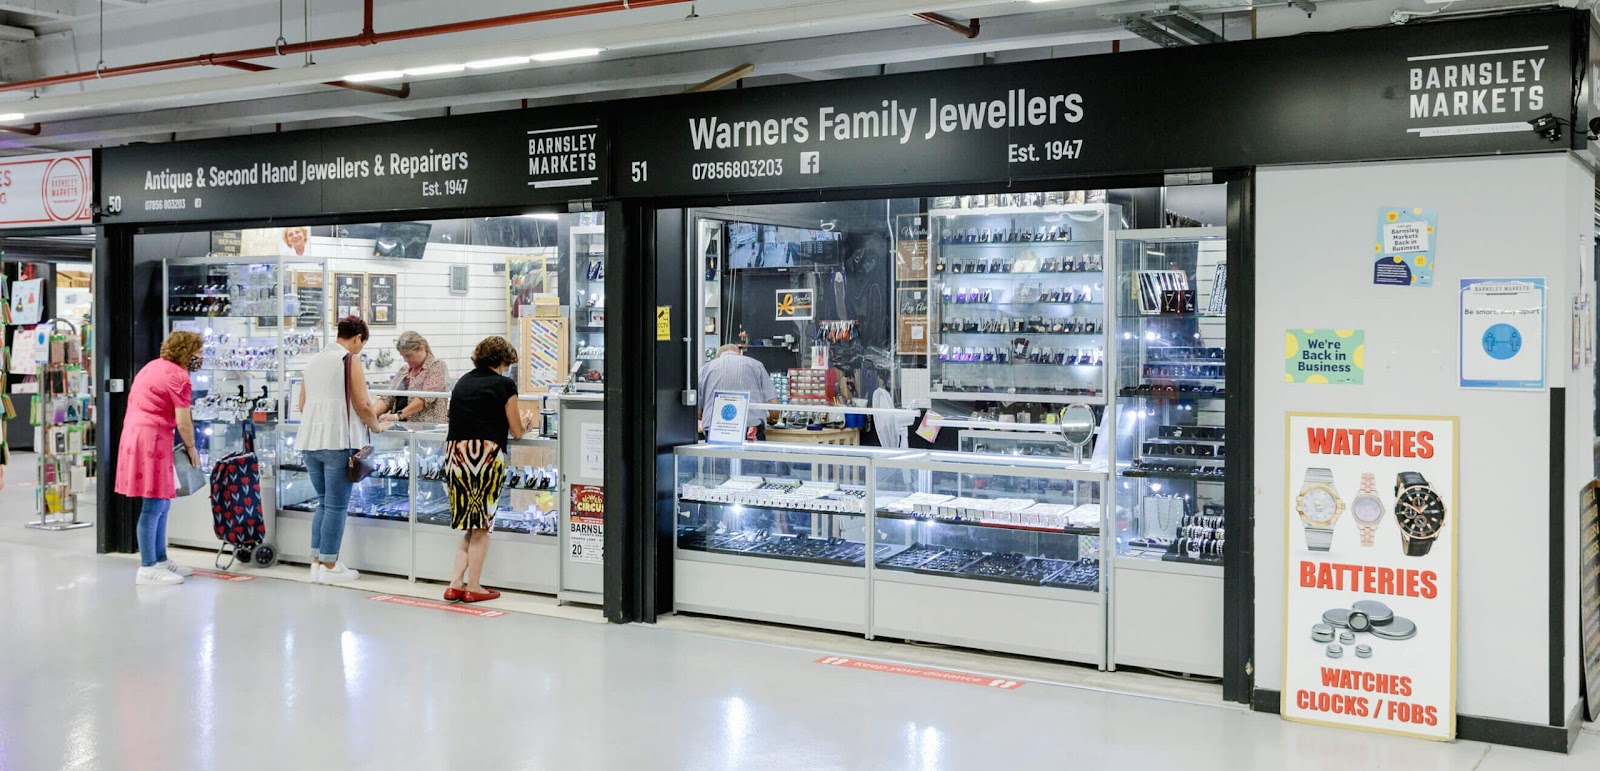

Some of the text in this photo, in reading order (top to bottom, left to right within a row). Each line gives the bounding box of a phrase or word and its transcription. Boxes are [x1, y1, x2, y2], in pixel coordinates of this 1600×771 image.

[1409, 58, 1546, 91] BARNSLEY
[1409, 85, 1544, 119] MARKETS
[689, 88, 1084, 150] Warners Family Jewellers
[528, 133, 597, 156] BARNSLEY
[1008, 139, 1083, 163] Est. 1947
[144, 148, 469, 193] Antique & Second Hand Jewellers & Repairers
[529, 153, 597, 176] MARKETS
[631, 161, 648, 183] 51
[691, 158, 783, 181] 07856803203
[51, 188, 78, 197] MARKETS
[422, 178, 468, 197] Est. 1947
[108, 196, 122, 213] 50
[144, 198, 186, 211] 07856 803203
[1391, 227, 1420, 235] Barnsley
[1518, 308, 1540, 316] apart
[1302, 349, 1347, 361] Back in
[1307, 338, 1341, 350] We're
[1297, 361, 1352, 373] Business
[1307, 427, 1435, 460] WATCHES
[572, 543, 582, 555] 20
[1299, 560, 1438, 600] BATTERIES
[889, 666, 921, 677] your
[922, 670, 982, 682] distance
[1320, 666, 1412, 697] WATCHES
[1296, 689, 1438, 727] CLOCKS / FOBS
